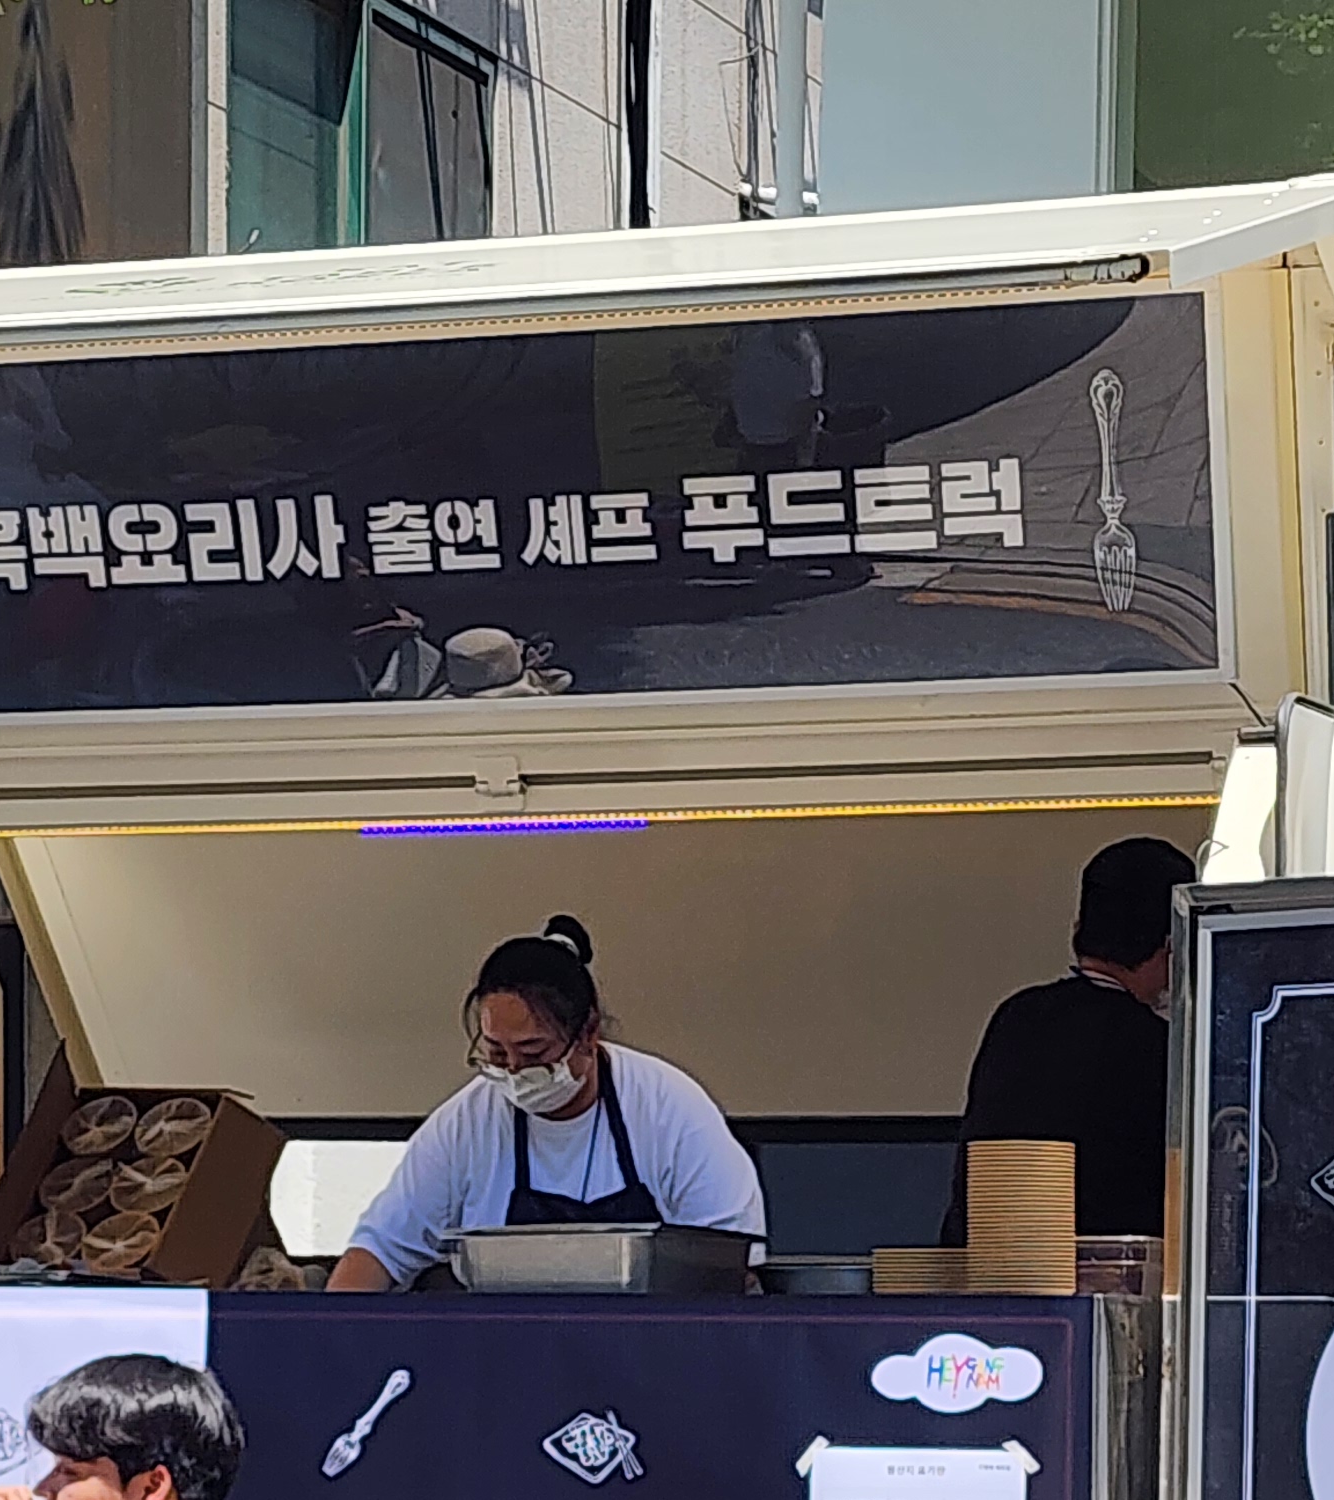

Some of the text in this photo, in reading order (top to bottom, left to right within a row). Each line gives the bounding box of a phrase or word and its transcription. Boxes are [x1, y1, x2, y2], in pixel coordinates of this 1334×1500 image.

[367, 498, 502, 575] 출연
[520, 491, 659, 566] 셰프
[681, 456, 1025, 564] 푸드트럭
